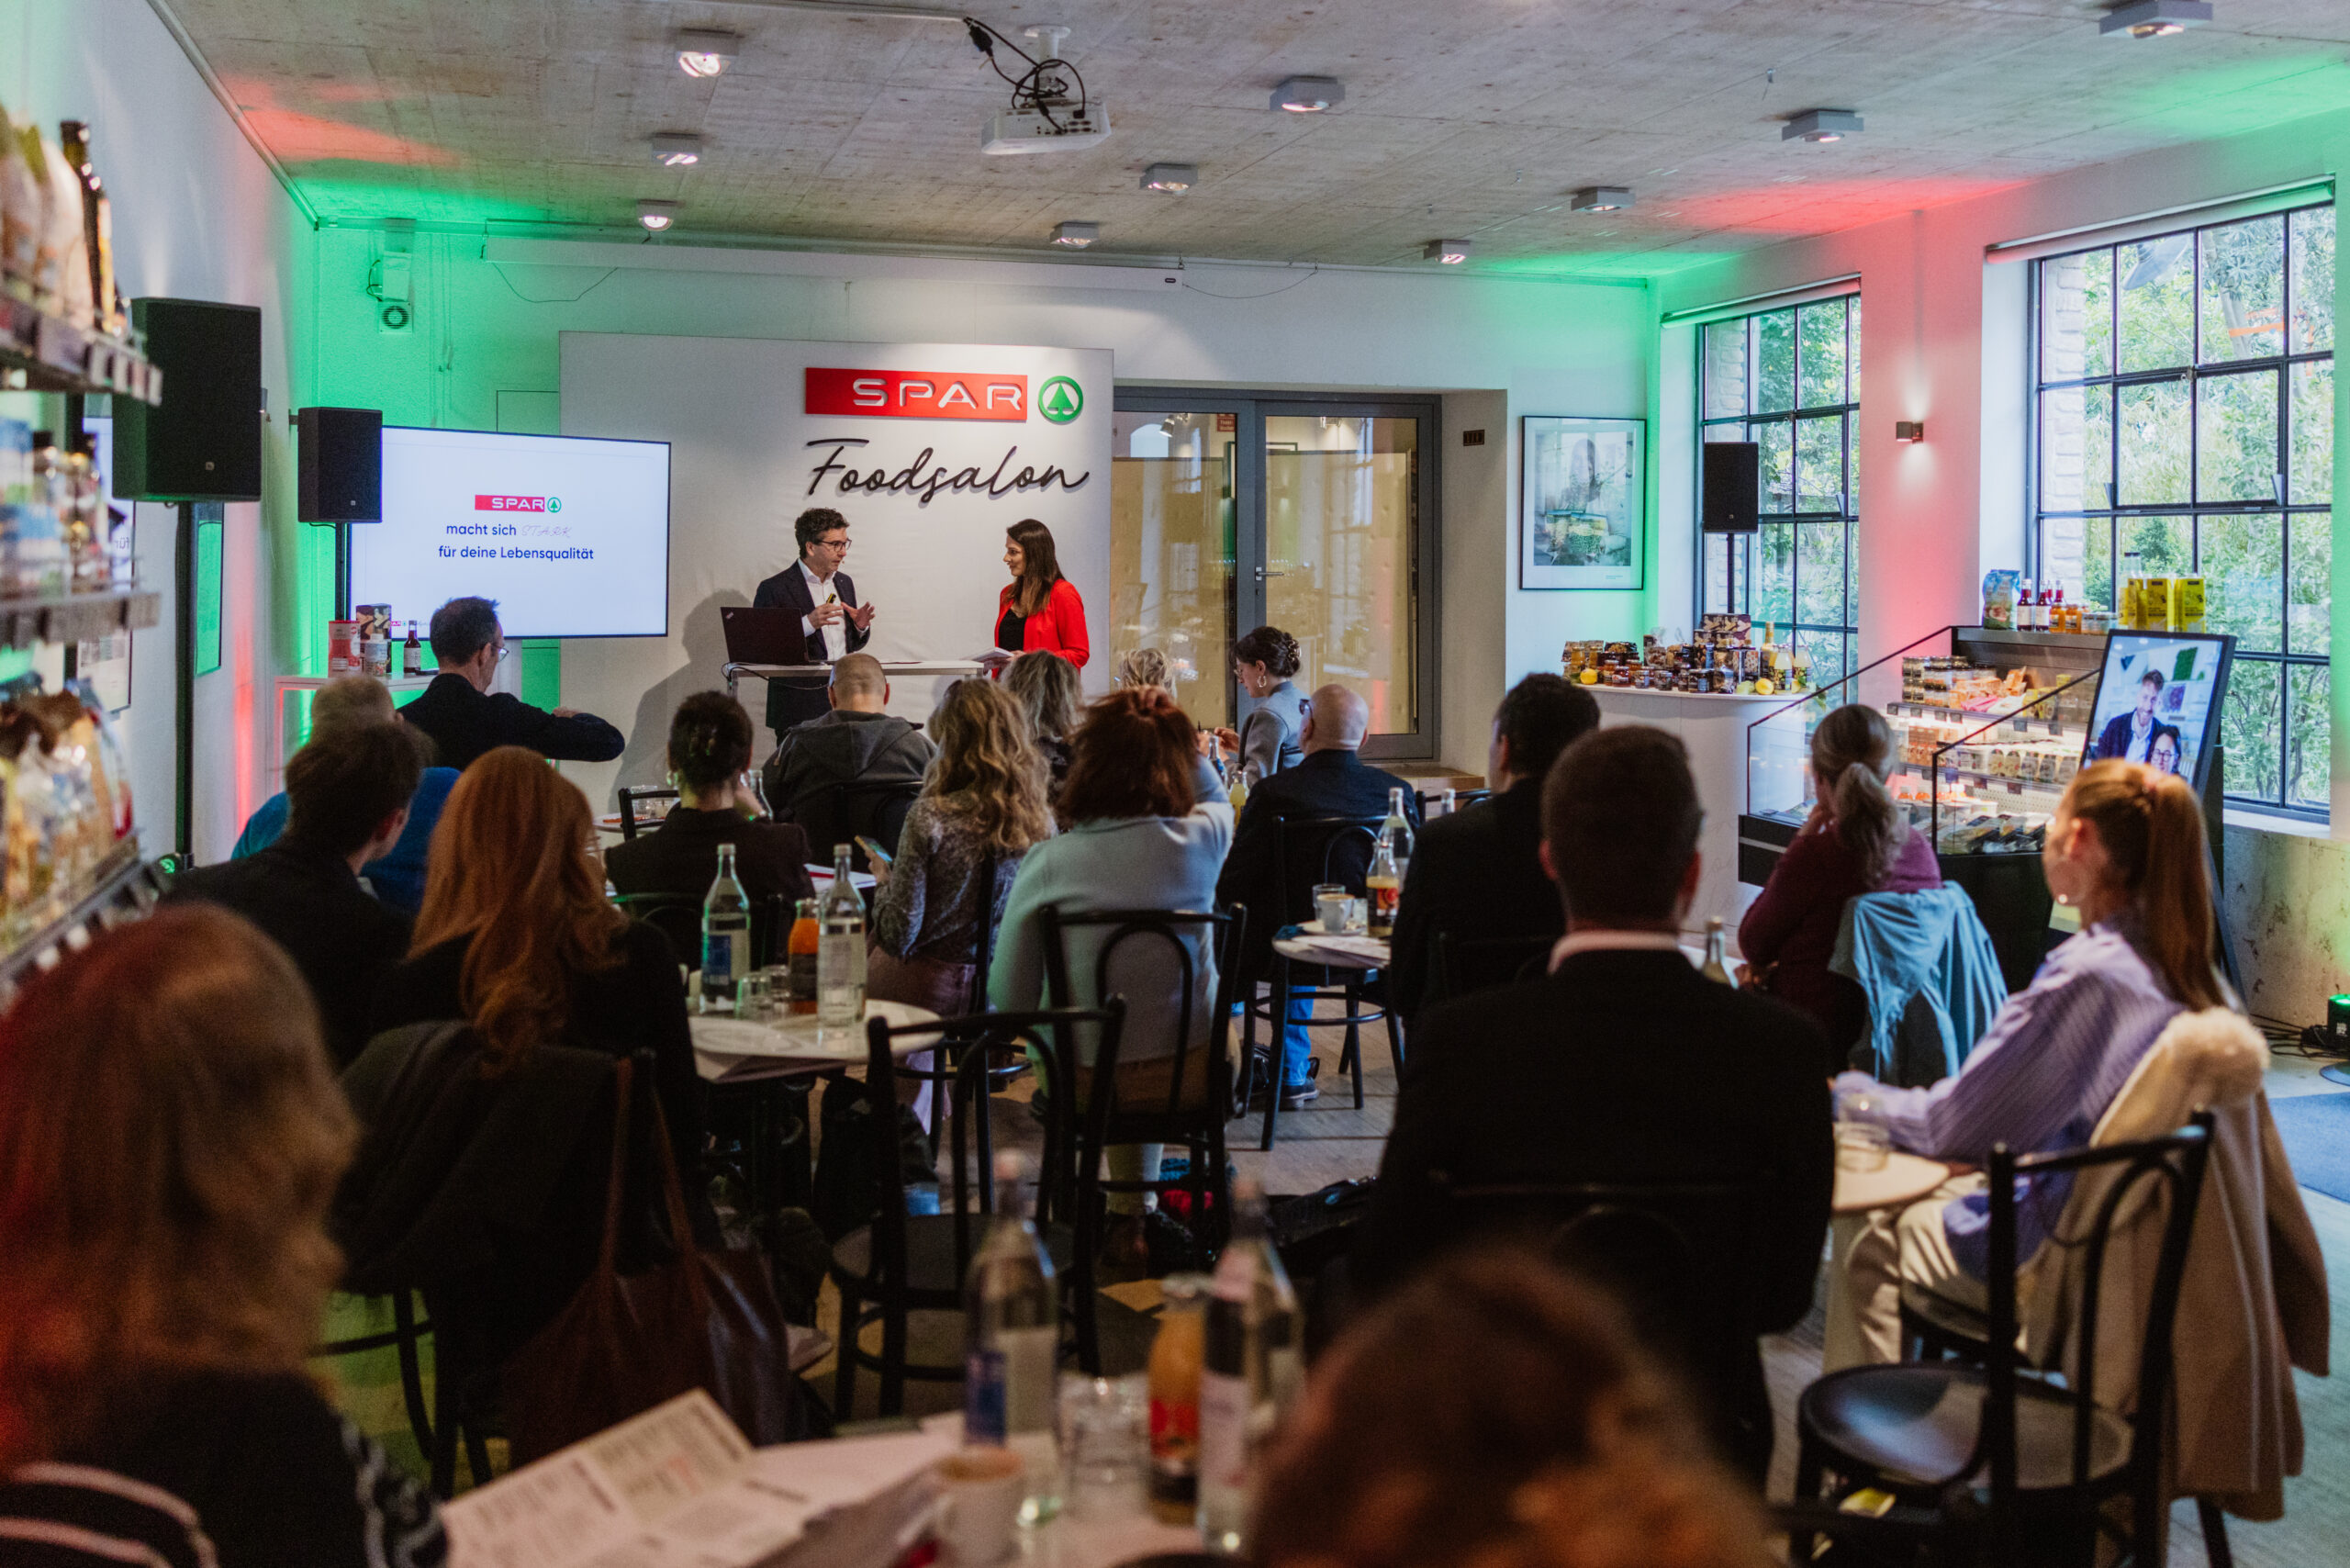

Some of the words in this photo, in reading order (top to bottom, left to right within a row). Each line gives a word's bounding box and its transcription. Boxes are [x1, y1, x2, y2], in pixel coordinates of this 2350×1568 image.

[853, 377, 1023, 410] SPAR
[806, 438, 1091, 503] Foodsalon
[491, 497, 544, 510] SPAR
[446, 522, 488, 535] macht
[491, 523, 517, 535] sich
[438, 545, 457, 557] für
[460, 545, 497, 558] deine
[500, 546, 594, 562] Lebensqualität
